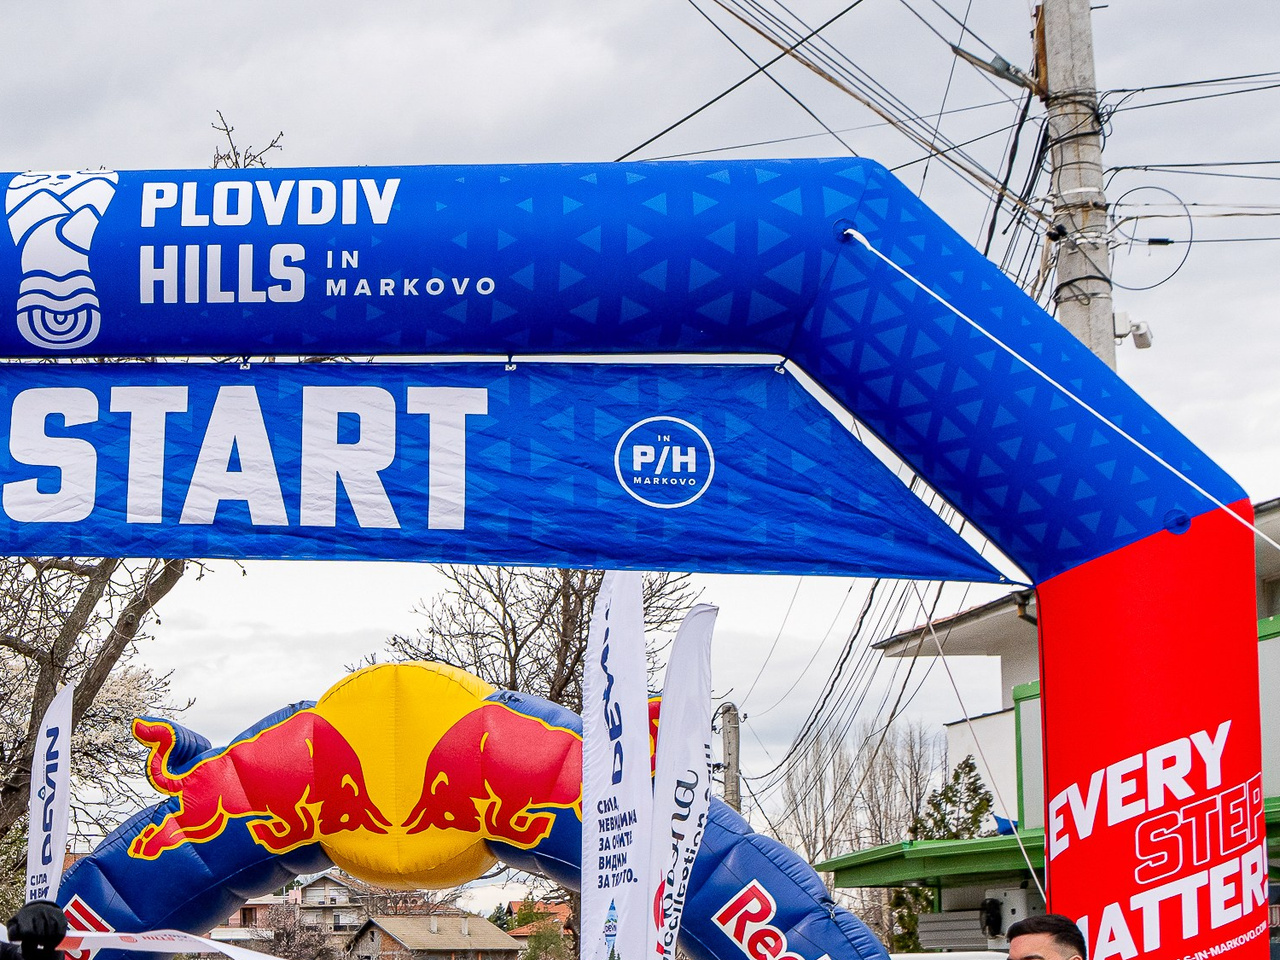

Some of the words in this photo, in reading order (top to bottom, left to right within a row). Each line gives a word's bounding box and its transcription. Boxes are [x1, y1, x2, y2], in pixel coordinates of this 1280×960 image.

[140, 178, 401, 227] PLOVDIV
[140, 243, 306, 304] HILLS
[326, 250, 360, 269] IN
[326, 276, 496, 297] MARKOVO
[2, 385, 489, 531] START
[632, 445, 696, 475] P/H
[633, 476, 696, 486] MARKOVO
[1049, 719, 1232, 863] EVERY
[1134, 771, 1264, 885] STEP
[599, 836, 611, 851] ЗА
[597, 874, 610, 889] ЗА
